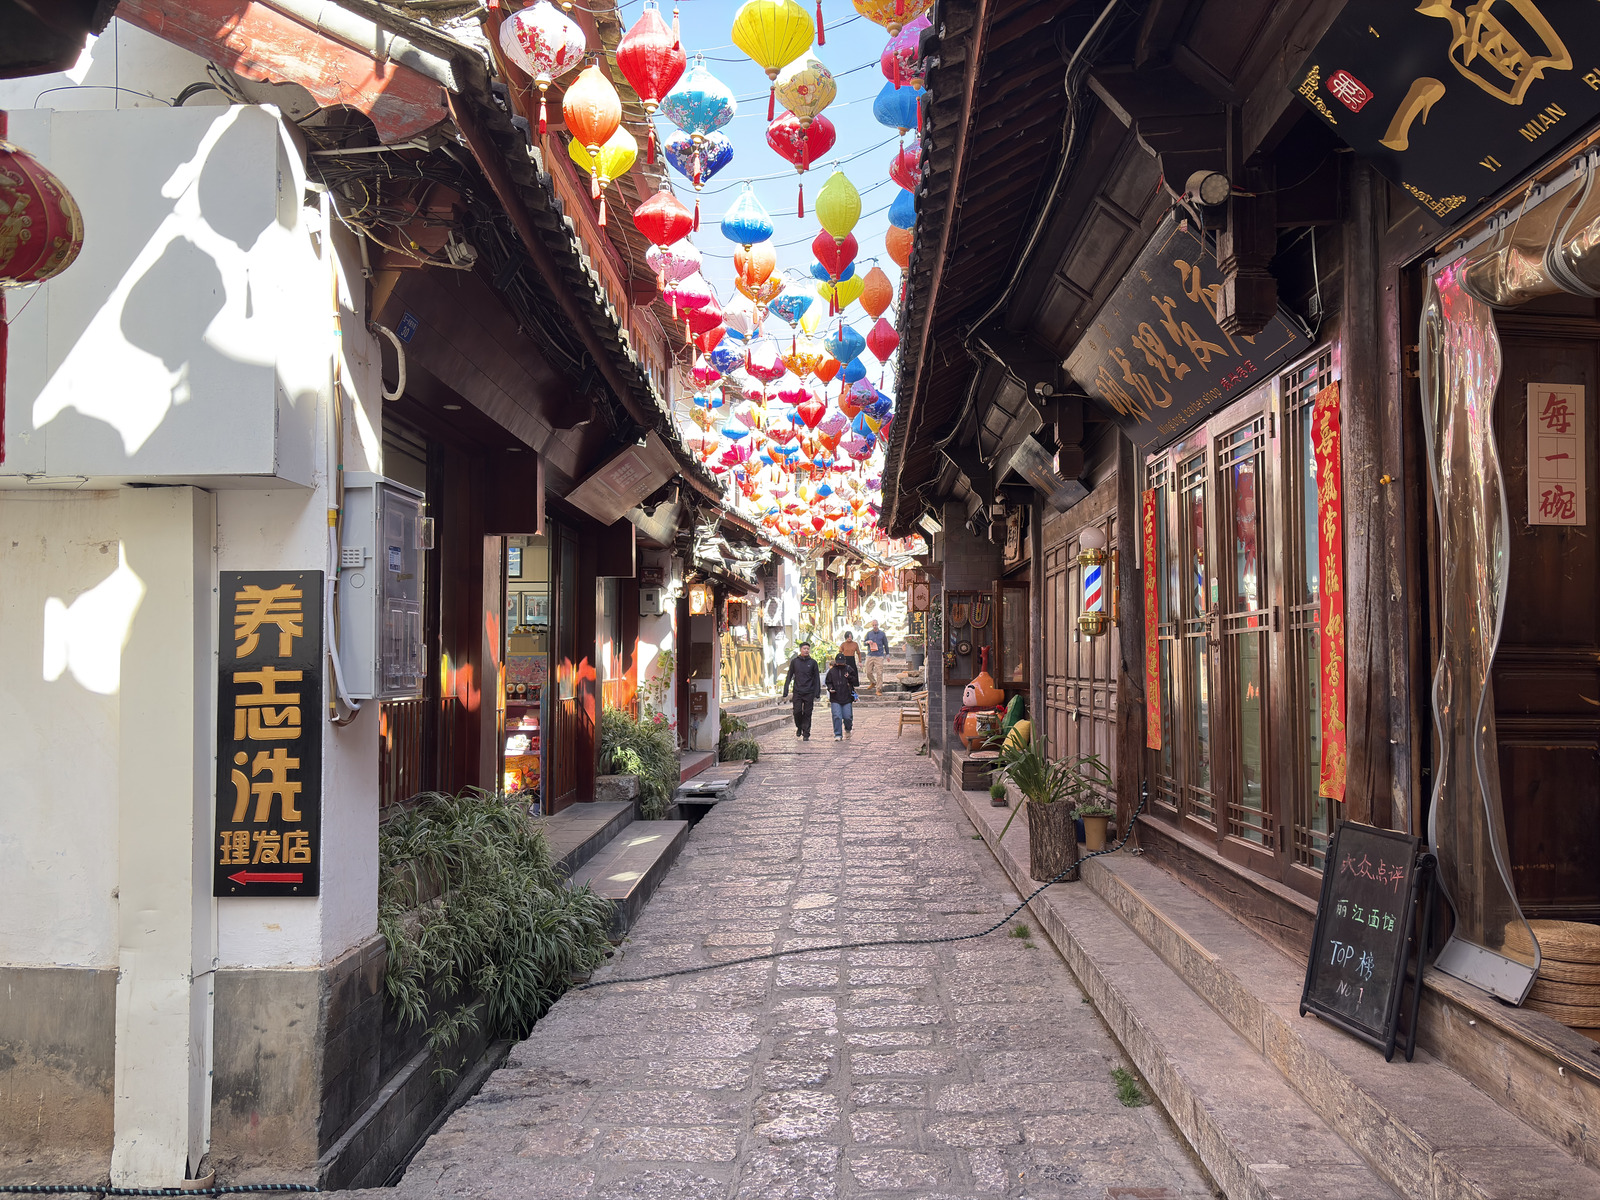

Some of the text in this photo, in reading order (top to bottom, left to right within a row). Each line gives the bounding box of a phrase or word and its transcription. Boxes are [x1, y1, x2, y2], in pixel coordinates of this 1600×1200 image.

[1479, 155, 1502, 172] YI
[1518, 102, 1567, 142] MIAN
[1181, 398, 1206, 418] barber
[1202, 387, 1223, 405] shop
[1539, 392, 1575, 520] 每一碗
[231, 584, 303, 823] 养志洗
[219, 830, 312, 865] 理发店
[1340, 853, 1405, 894] 大众点评
[1336, 899, 1397, 933] 丽江面馆
[1355, 951, 1374, 981] 榜
